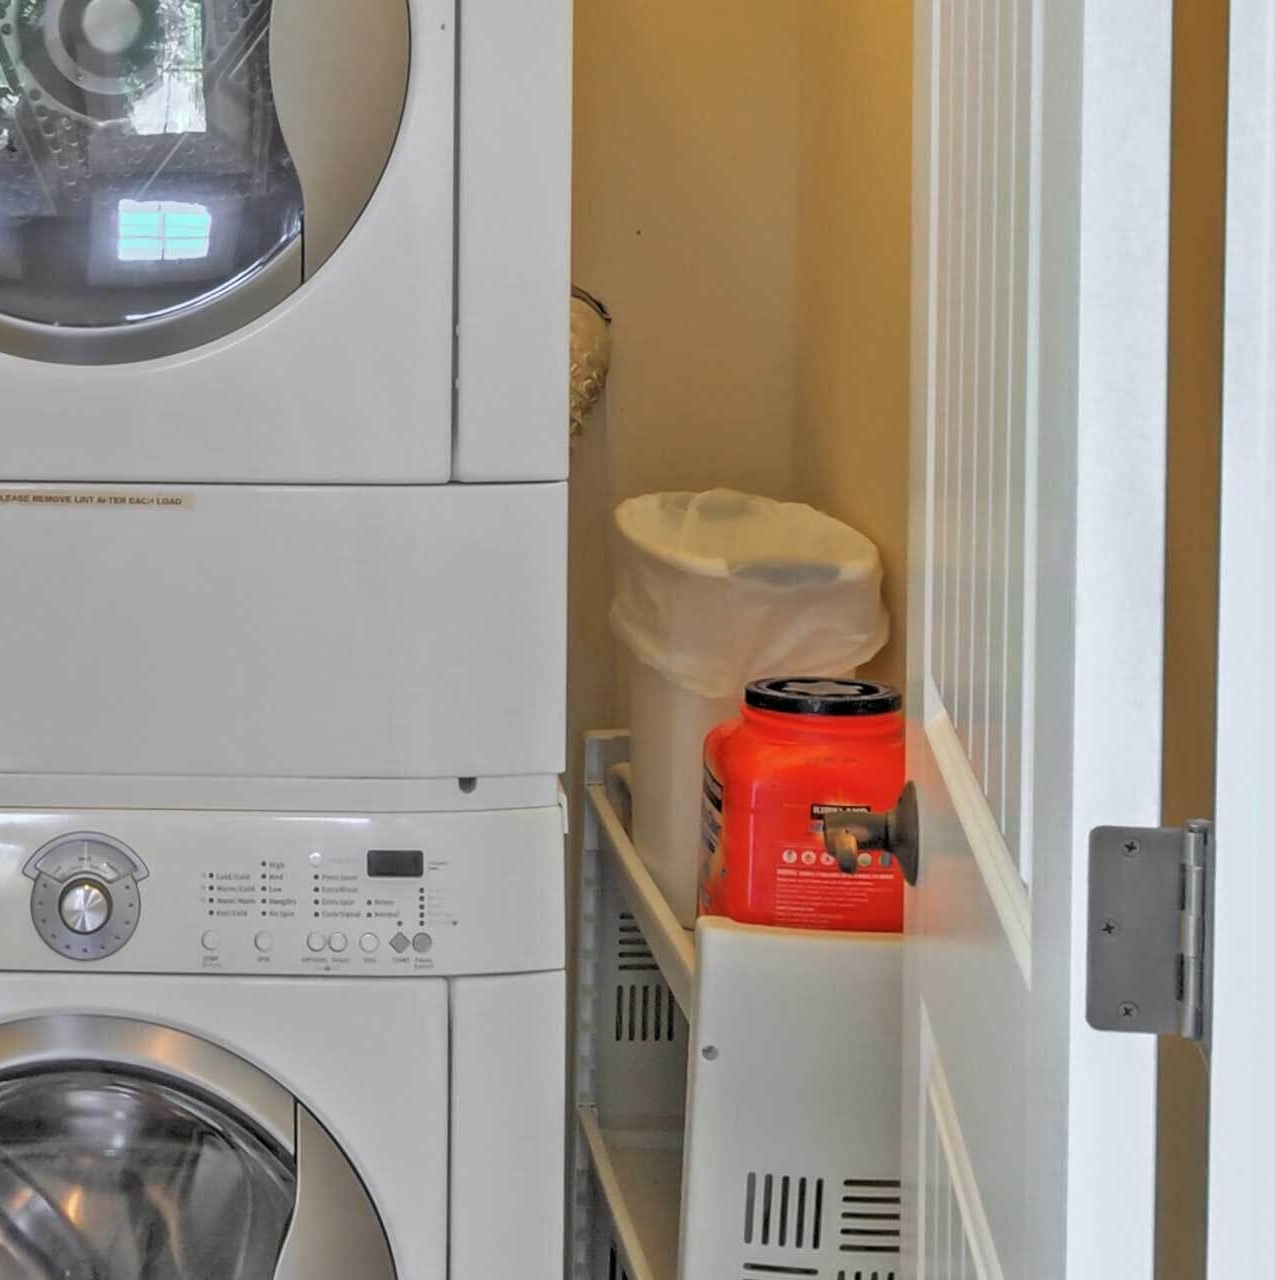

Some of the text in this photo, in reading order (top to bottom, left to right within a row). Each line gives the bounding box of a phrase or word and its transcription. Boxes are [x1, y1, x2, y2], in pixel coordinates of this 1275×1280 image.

[32, 495, 70, 504] REMOVE
[74, 495, 94, 505] LINT
[157, 497, 182, 506] LOAD
